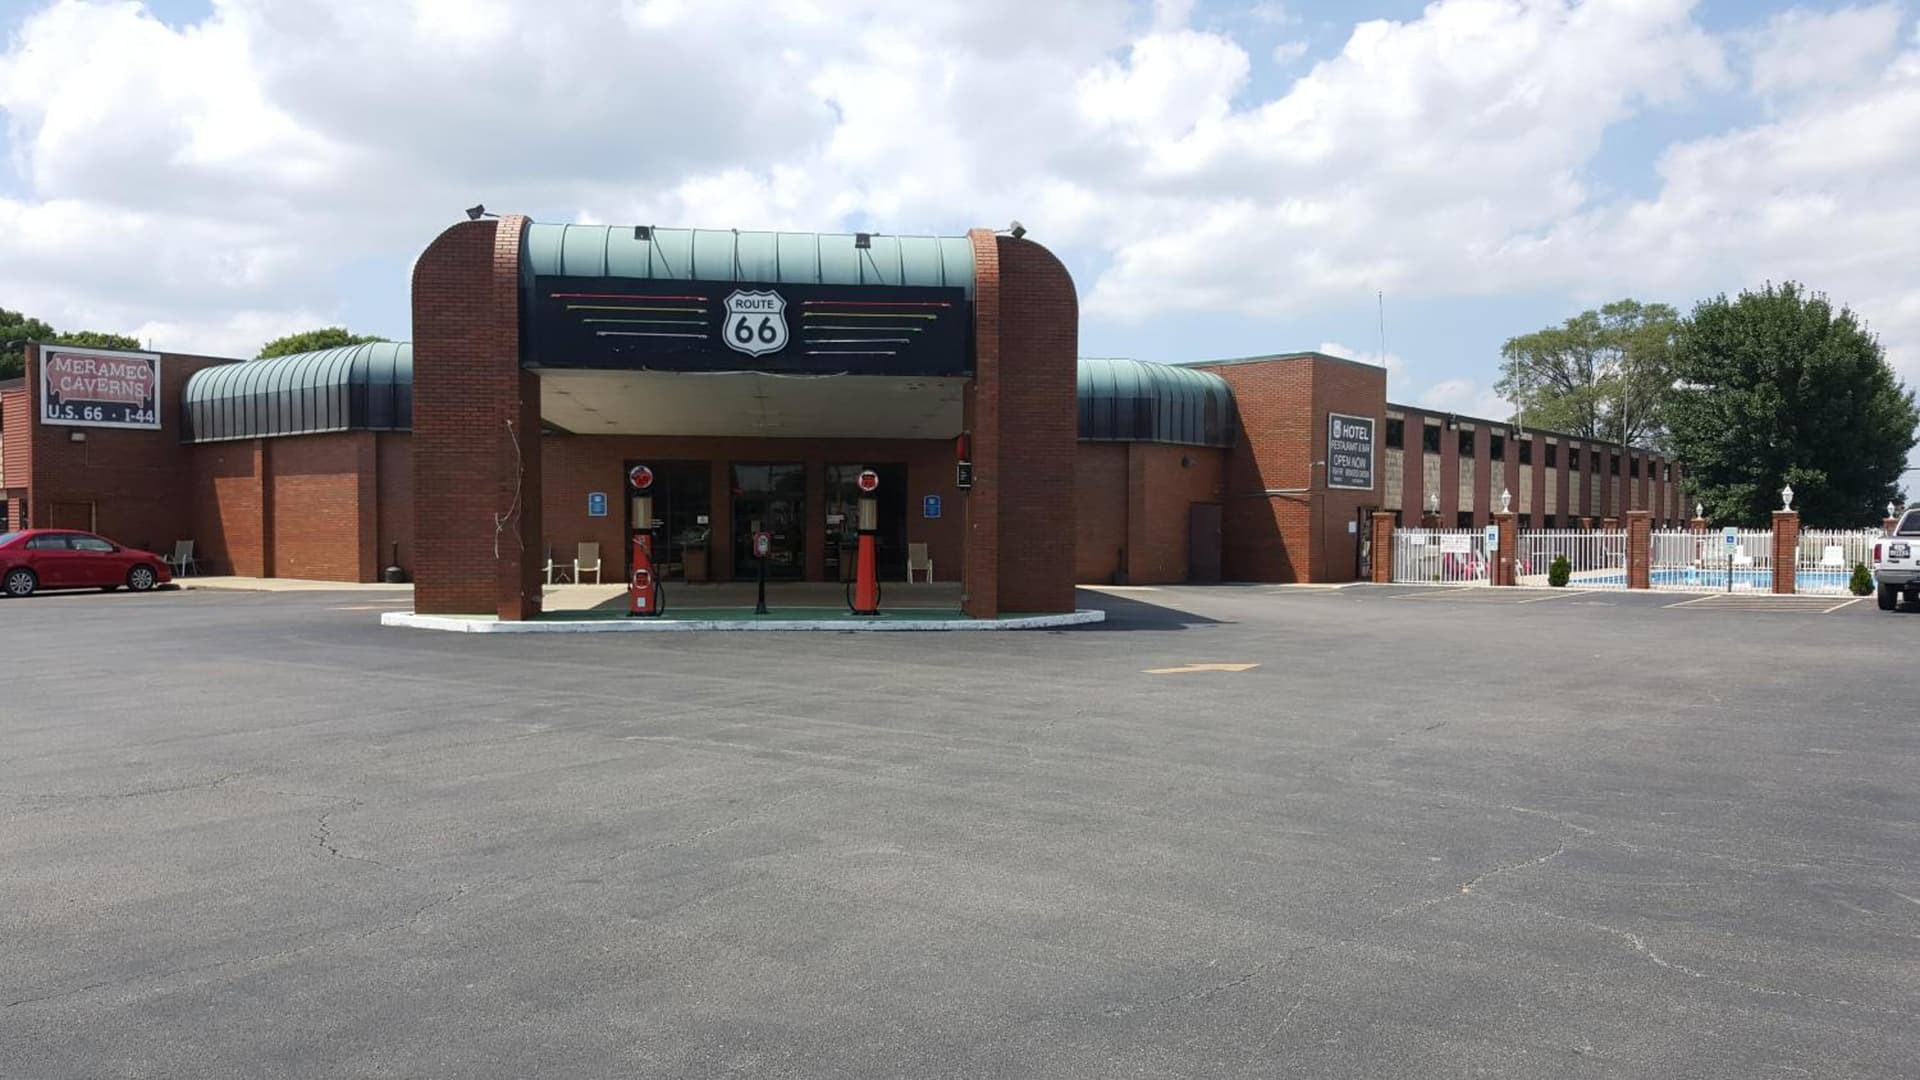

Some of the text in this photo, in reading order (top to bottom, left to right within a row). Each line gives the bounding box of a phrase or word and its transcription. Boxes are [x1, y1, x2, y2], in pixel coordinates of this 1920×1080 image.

[735, 298, 775, 309] ROUTE
[735, 315, 777, 344] 66
[55, 357, 148, 380] MERAMEC
[60, 376, 145, 397] CAVERNS
[48, 404, 154, 422] U.S. 66 I-44
[1342, 424, 1369, 440] HOTEL
[1333, 454, 1366, 469] OPEN NOW
